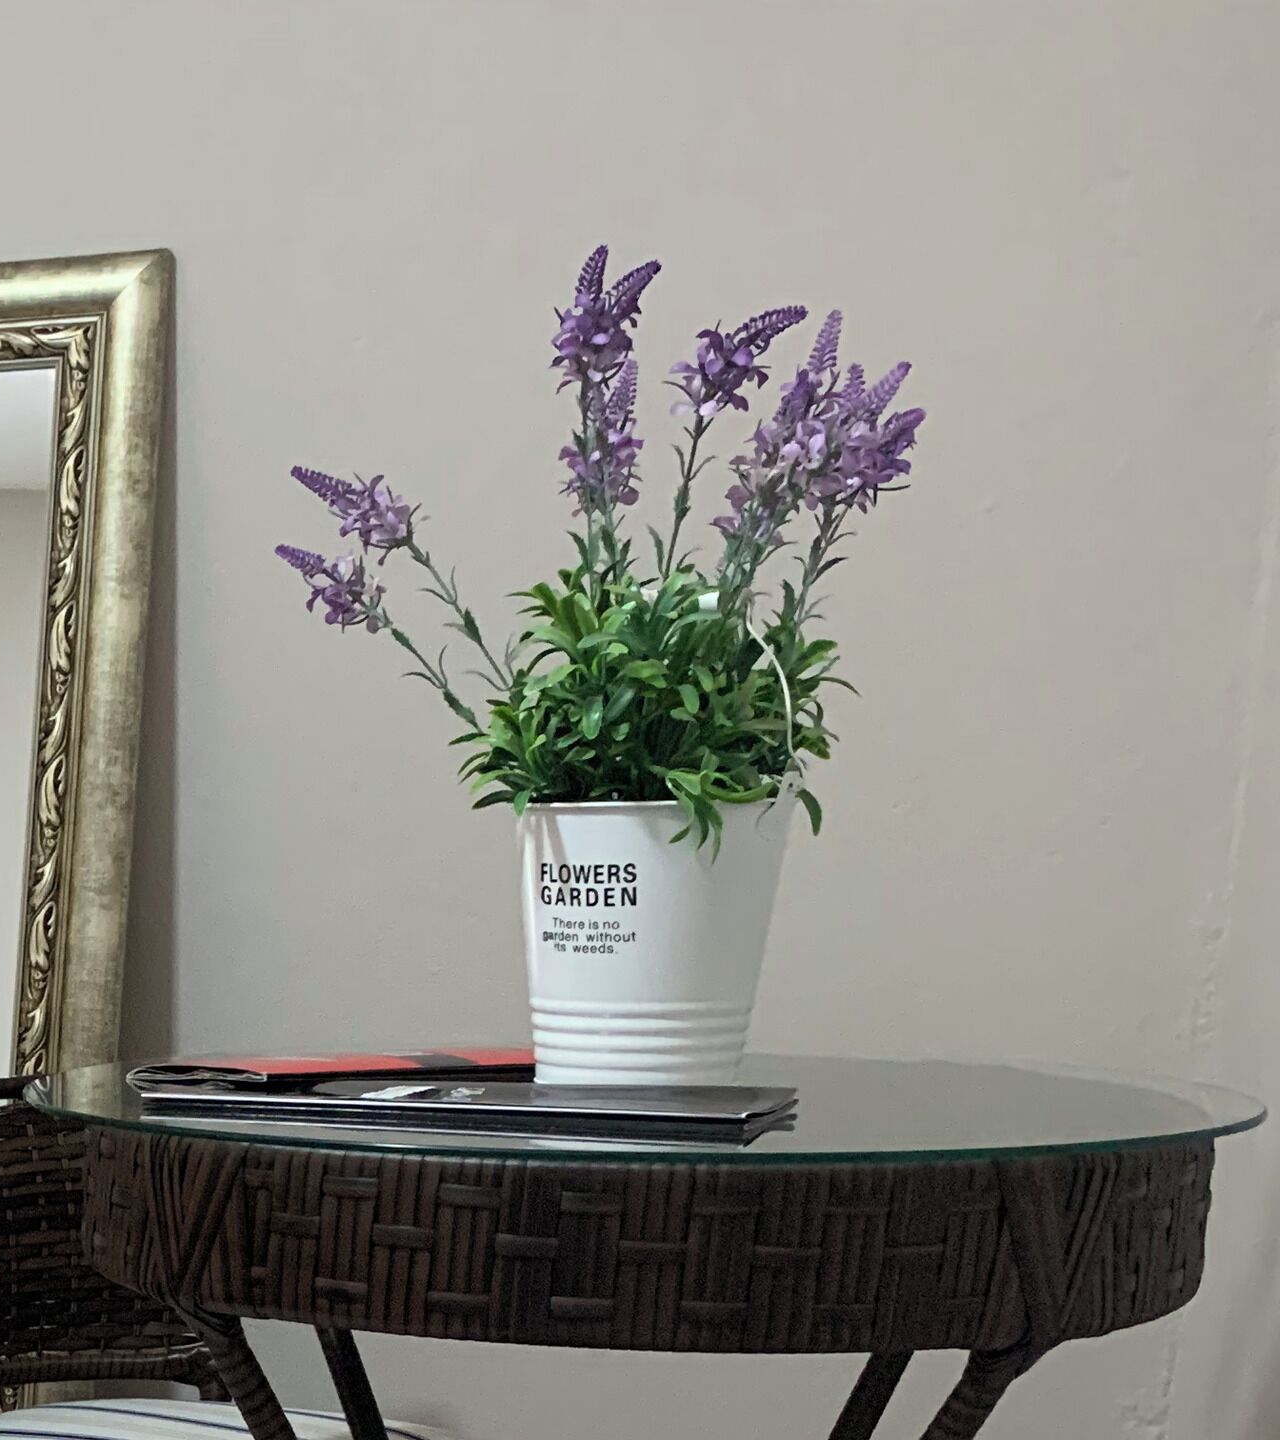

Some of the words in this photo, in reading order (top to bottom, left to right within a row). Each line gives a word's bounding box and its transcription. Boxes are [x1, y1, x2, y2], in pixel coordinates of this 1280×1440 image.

[541, 863, 638, 884] FLOWERS
[541, 886, 638, 907] GARDEN
[552, 917, 585, 930] There
[588, 920, 599, 930] is
[602, 920, 620, 930] no
[542, 931, 579, 942] garden
[586, 931, 636, 943] without
